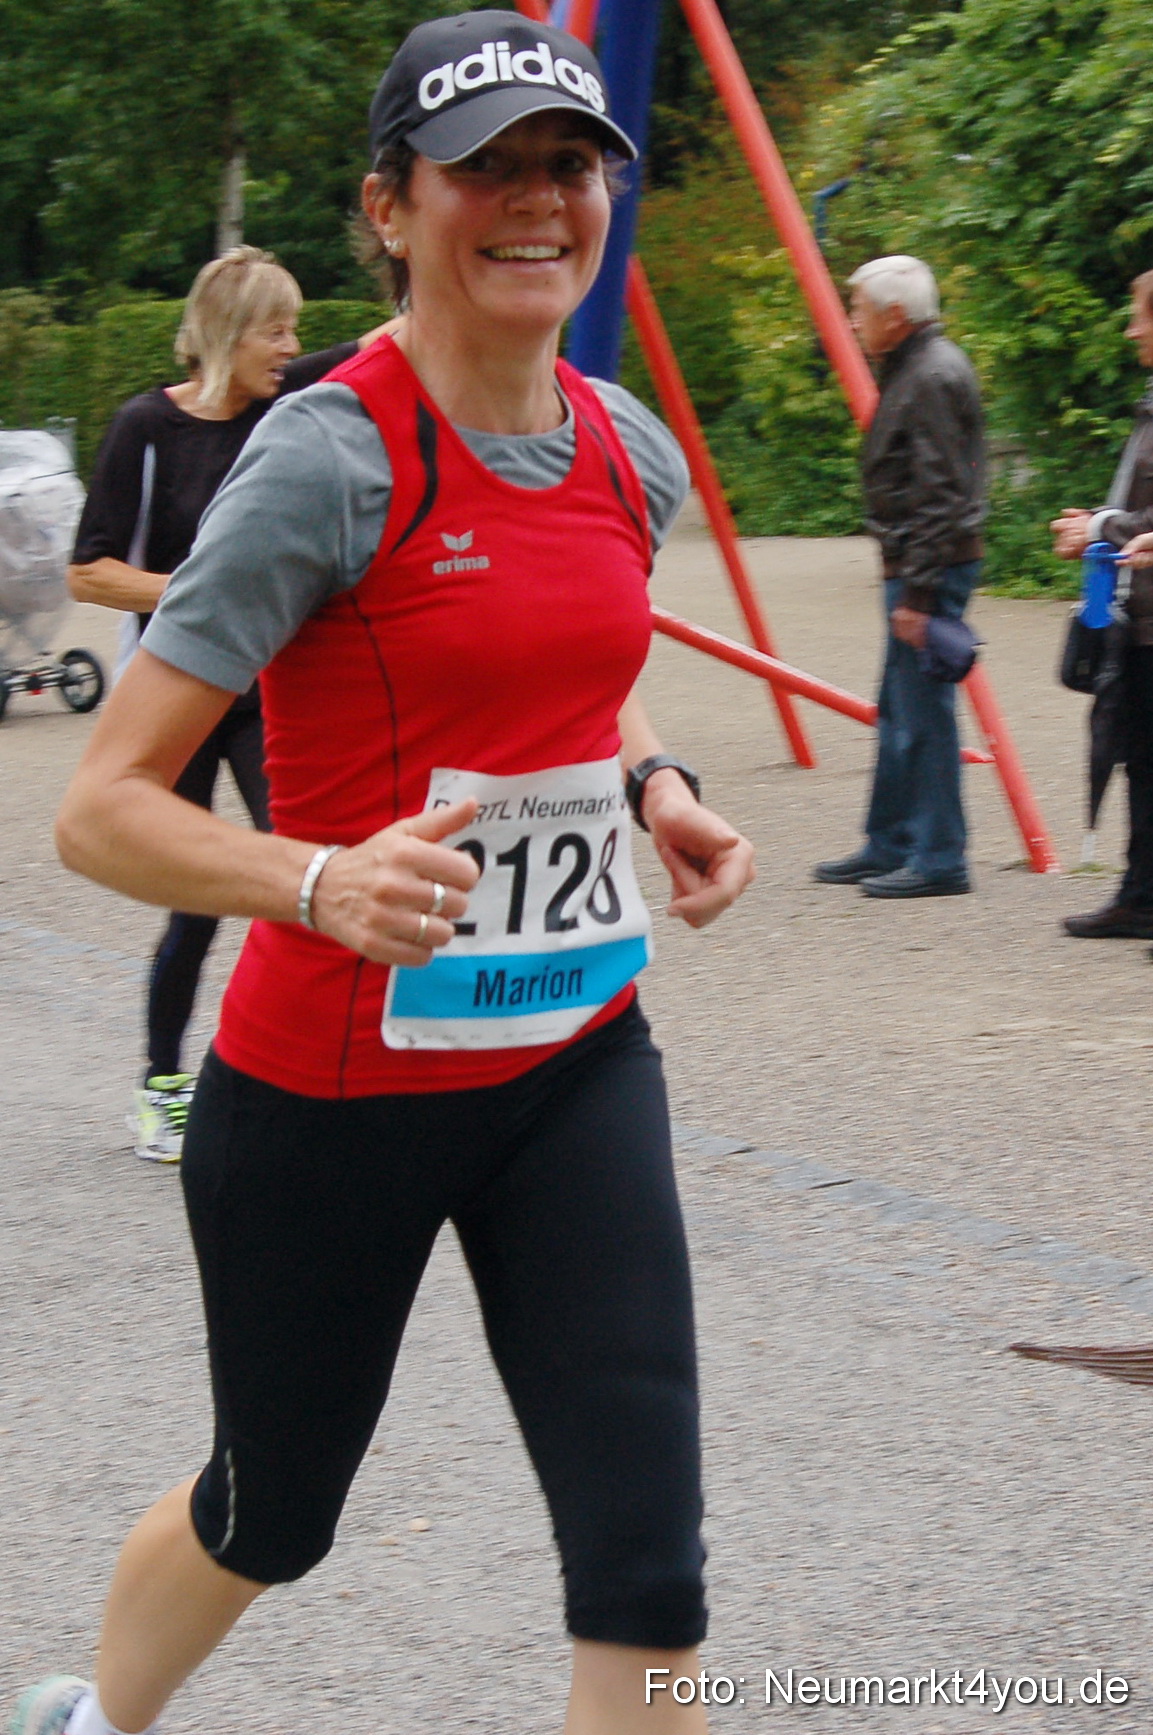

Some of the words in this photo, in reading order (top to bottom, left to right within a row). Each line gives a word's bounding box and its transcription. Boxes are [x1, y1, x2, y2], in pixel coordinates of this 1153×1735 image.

[419, 41, 605, 113] adidas
[433, 555, 490, 575] erima
[473, 966, 583, 1007] Marion
